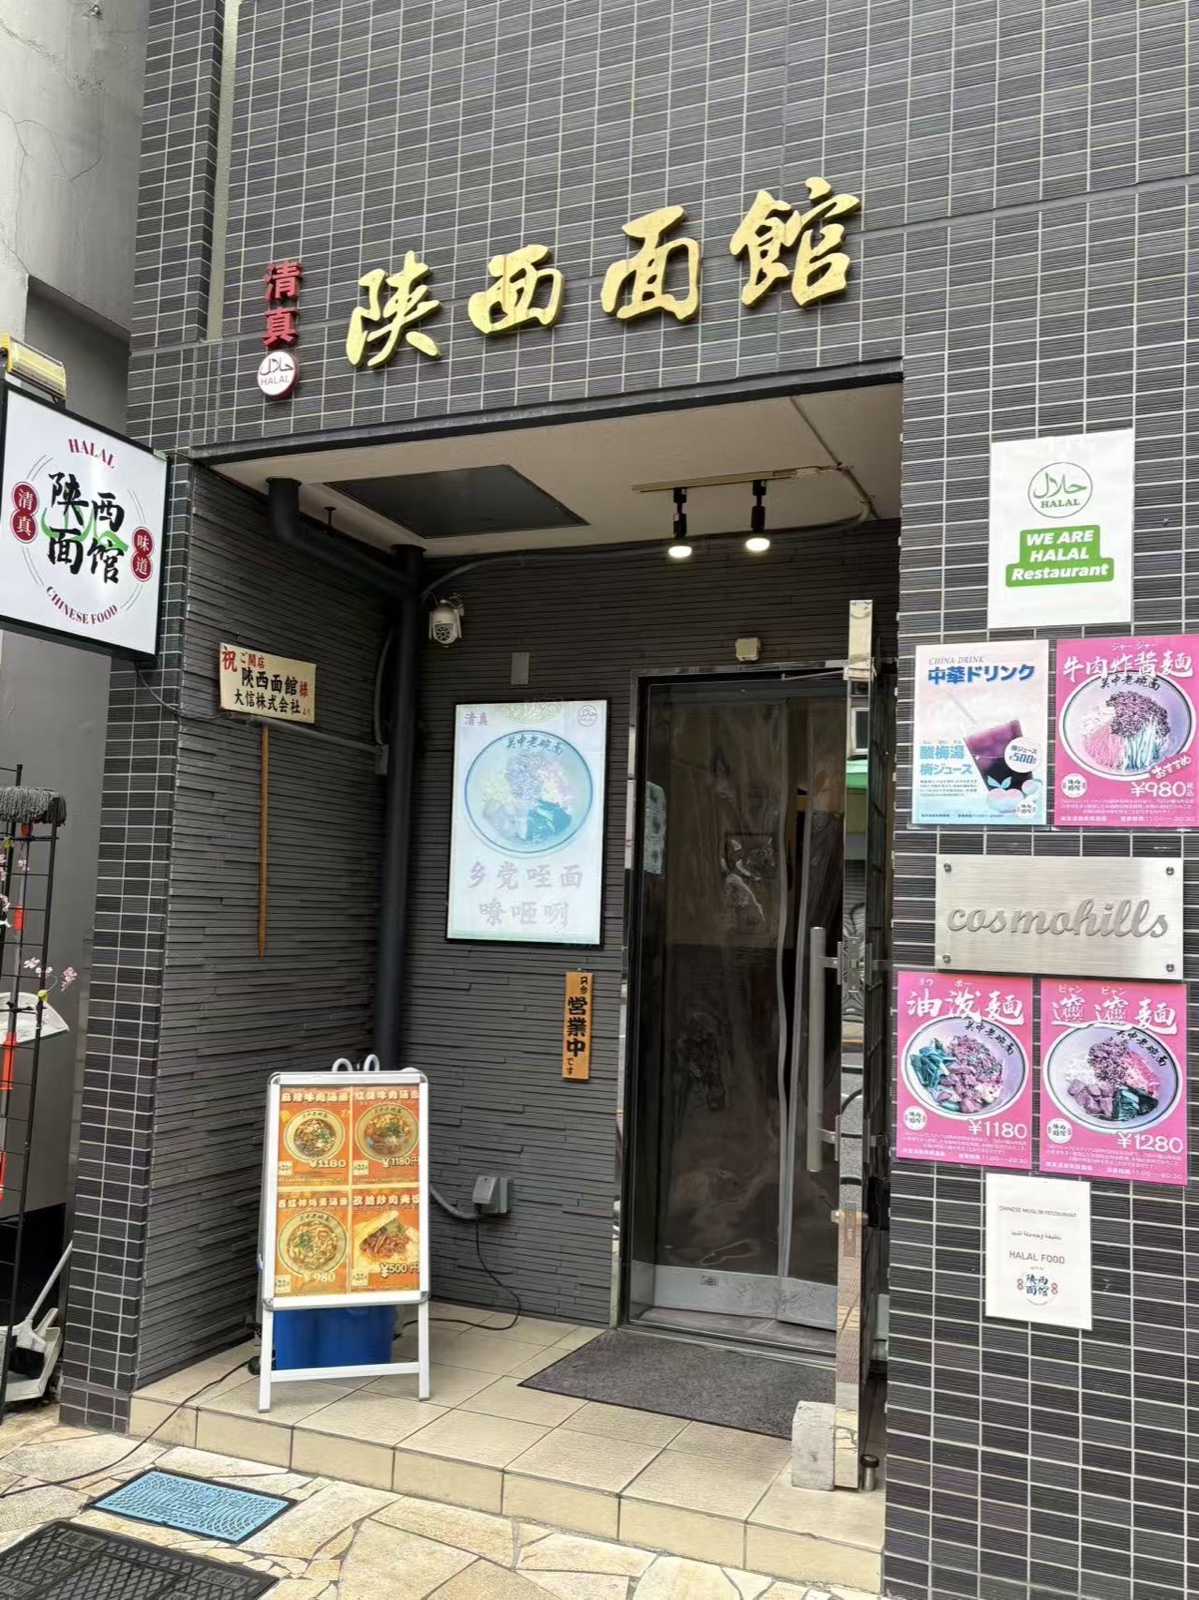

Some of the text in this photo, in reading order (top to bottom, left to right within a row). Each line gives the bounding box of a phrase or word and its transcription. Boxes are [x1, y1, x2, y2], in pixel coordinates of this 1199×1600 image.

[263, 260, 304, 348] 清真
[260, 375, 291, 386] HALAL
[68, 438, 116, 468] HALAL
[1033, 471, 1087, 499] حلال
[16, 488, 34, 537] 清真
[1040, 498, 1080, 509] HALAL
[1026, 530, 1095, 546] WE ARE
[135, 534, 150, 576] 味道
[1029, 546, 1090, 563] HALAL
[1011, 563, 1109, 581] Restaurant
[46, 586, 118, 625] CHINESE FOOD
[222, 646, 238, 673] 祝
[928, 655, 985, 665] CHINA DRINK
[928, 664, 1036, 685] 中華ドリンク
[1151, 755, 1192, 779] おすすめ
[1130, 780, 1186, 798] ¥980
[946, 897, 1169, 939] cosmohills
[968, 1118, 1028, 1140] ¥1180
[1116, 1131, 1184, 1154] ¥1280
[309, 1160, 347, 1169] ¥1180
[1009, 1250, 1065, 1265] HALAL FOOD
